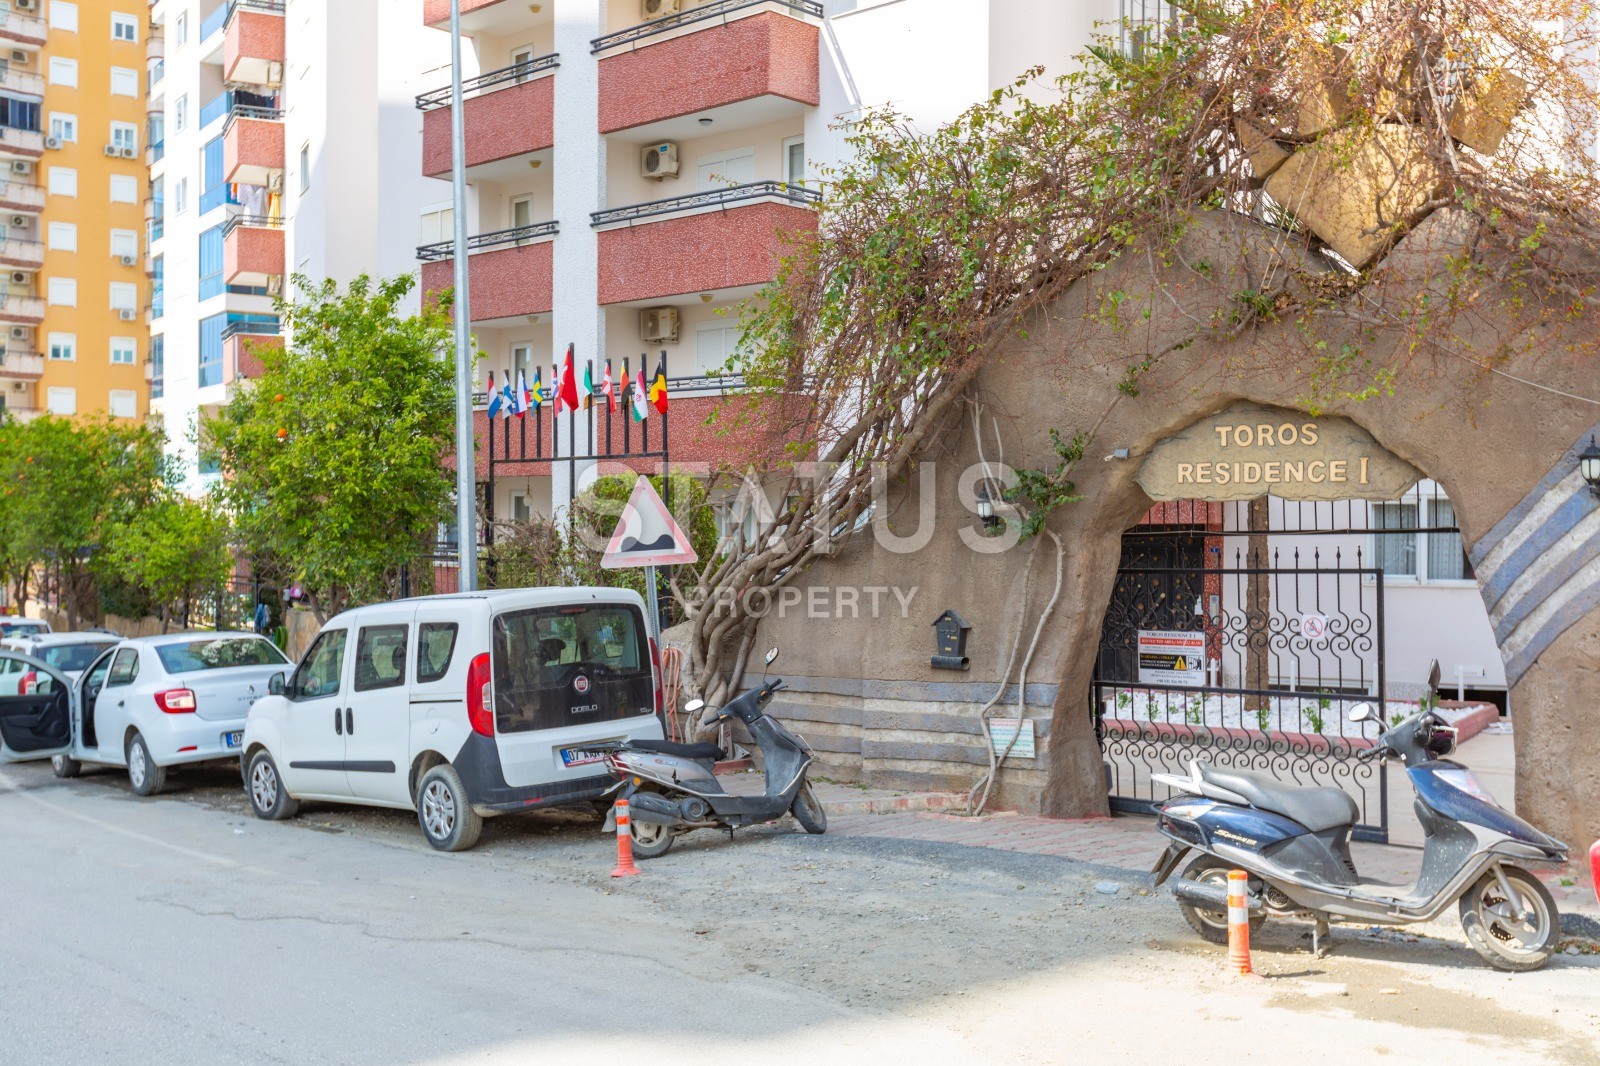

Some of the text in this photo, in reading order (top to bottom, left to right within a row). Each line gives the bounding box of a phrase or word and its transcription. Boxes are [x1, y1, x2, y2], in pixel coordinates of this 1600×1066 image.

[1214, 422, 1319, 448] TOROS
[1177, 460, 1348, 485] RESIDENCE
[571, 704, 598, 714] DOBLO
[233, 733, 242, 743] 07
